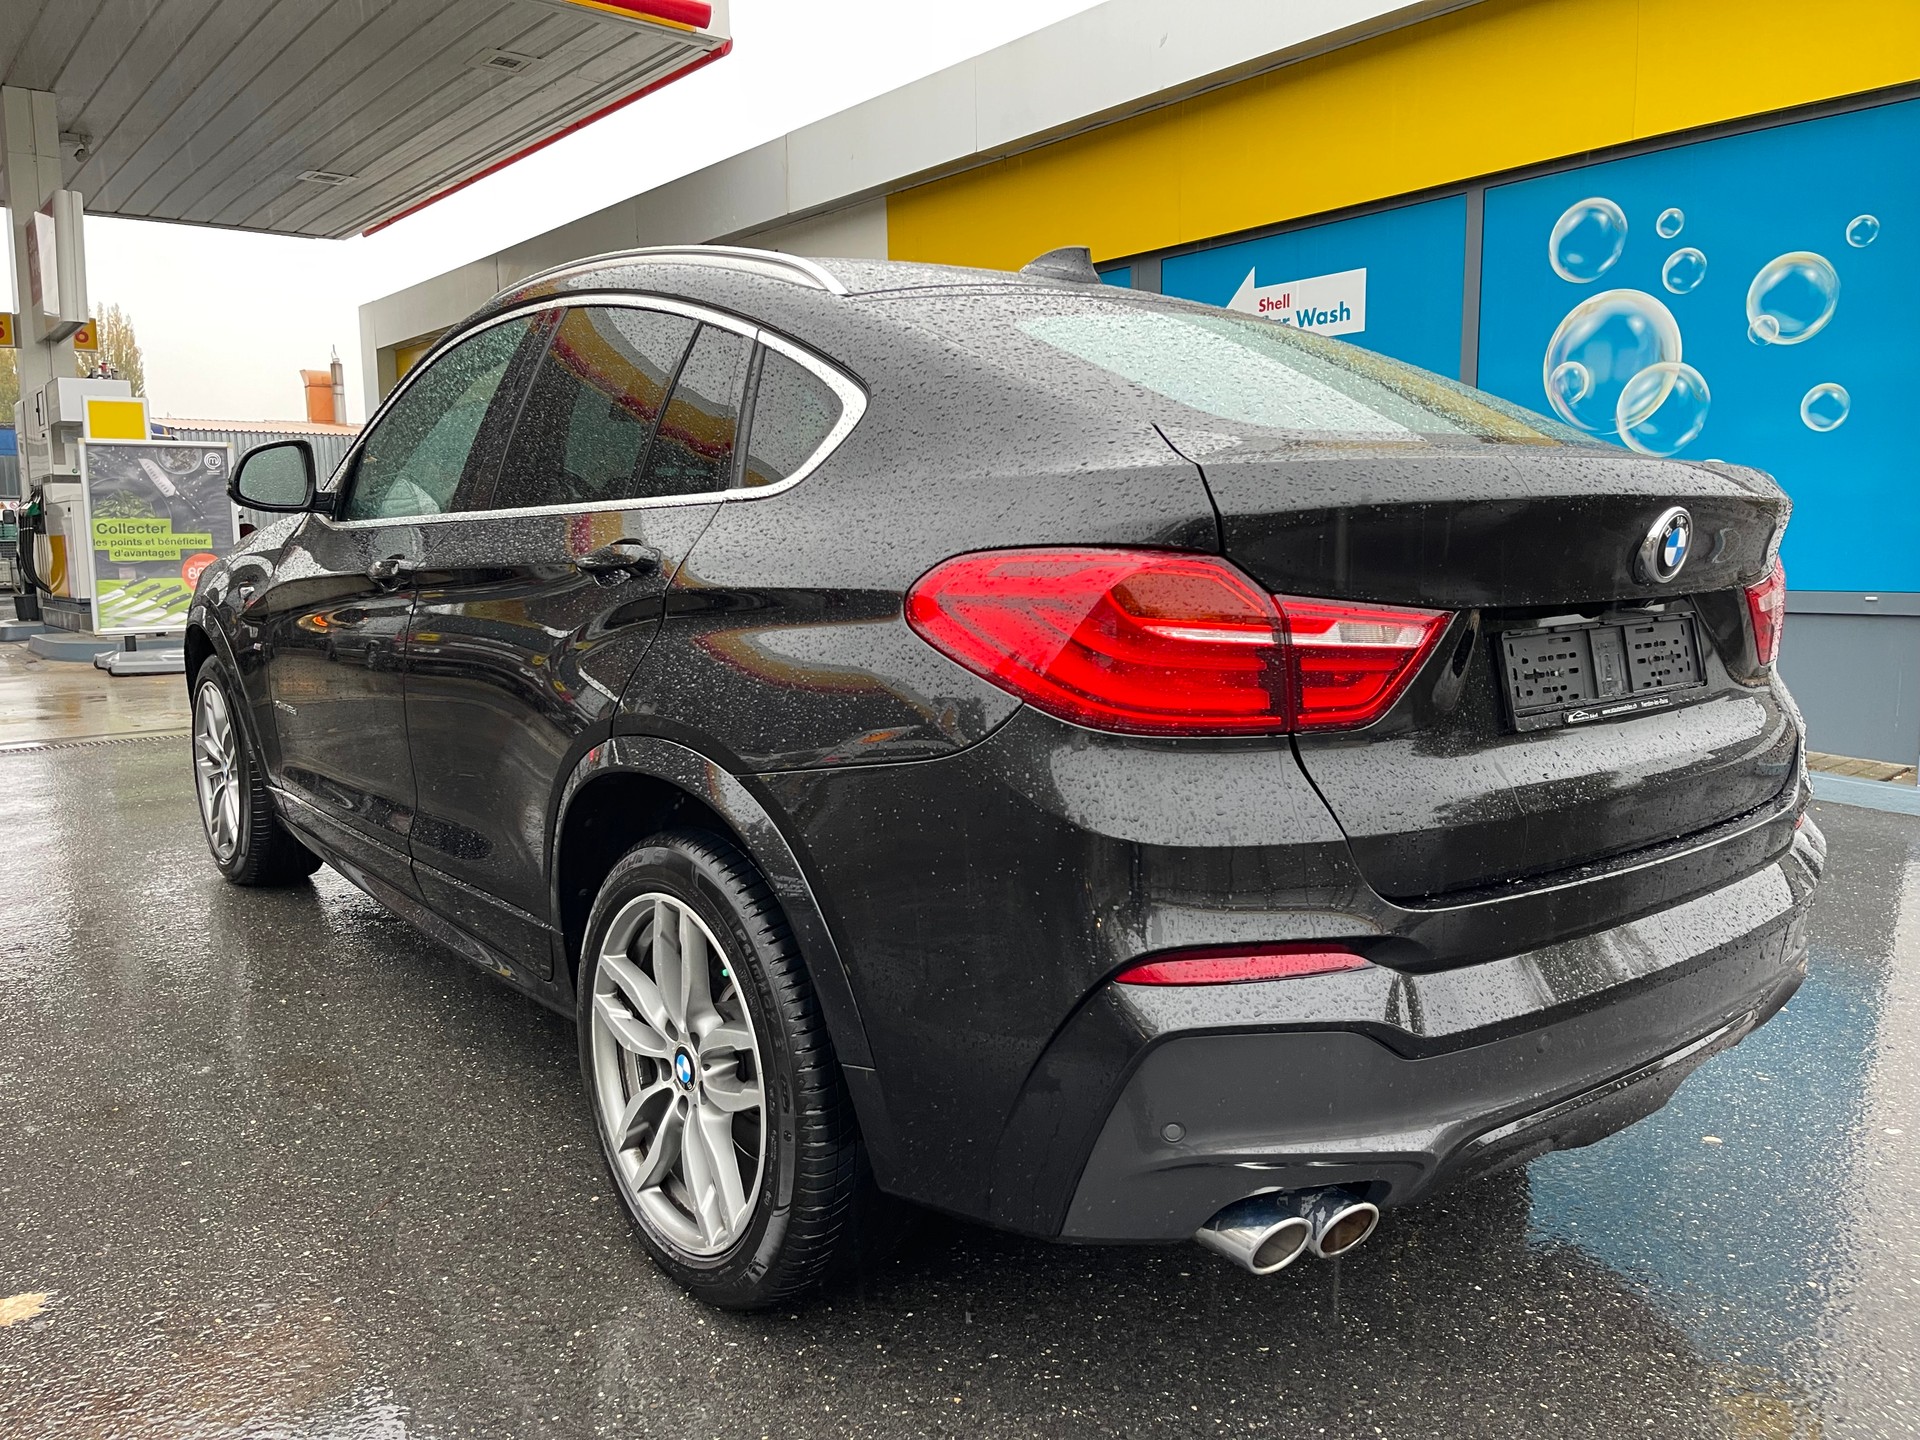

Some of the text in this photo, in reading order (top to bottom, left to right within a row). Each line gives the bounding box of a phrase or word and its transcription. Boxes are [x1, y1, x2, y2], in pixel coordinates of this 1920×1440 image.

[1258, 293, 1290, 312] Shell
[1296, 301, 1351, 328] Wash
[96, 523, 167, 535] Collecter
[110, 538, 142, 548] points
[145, 538, 155, 546] et
[158, 537, 208, 546] bénéficier
[114, 549, 176, 559] d'avantages
